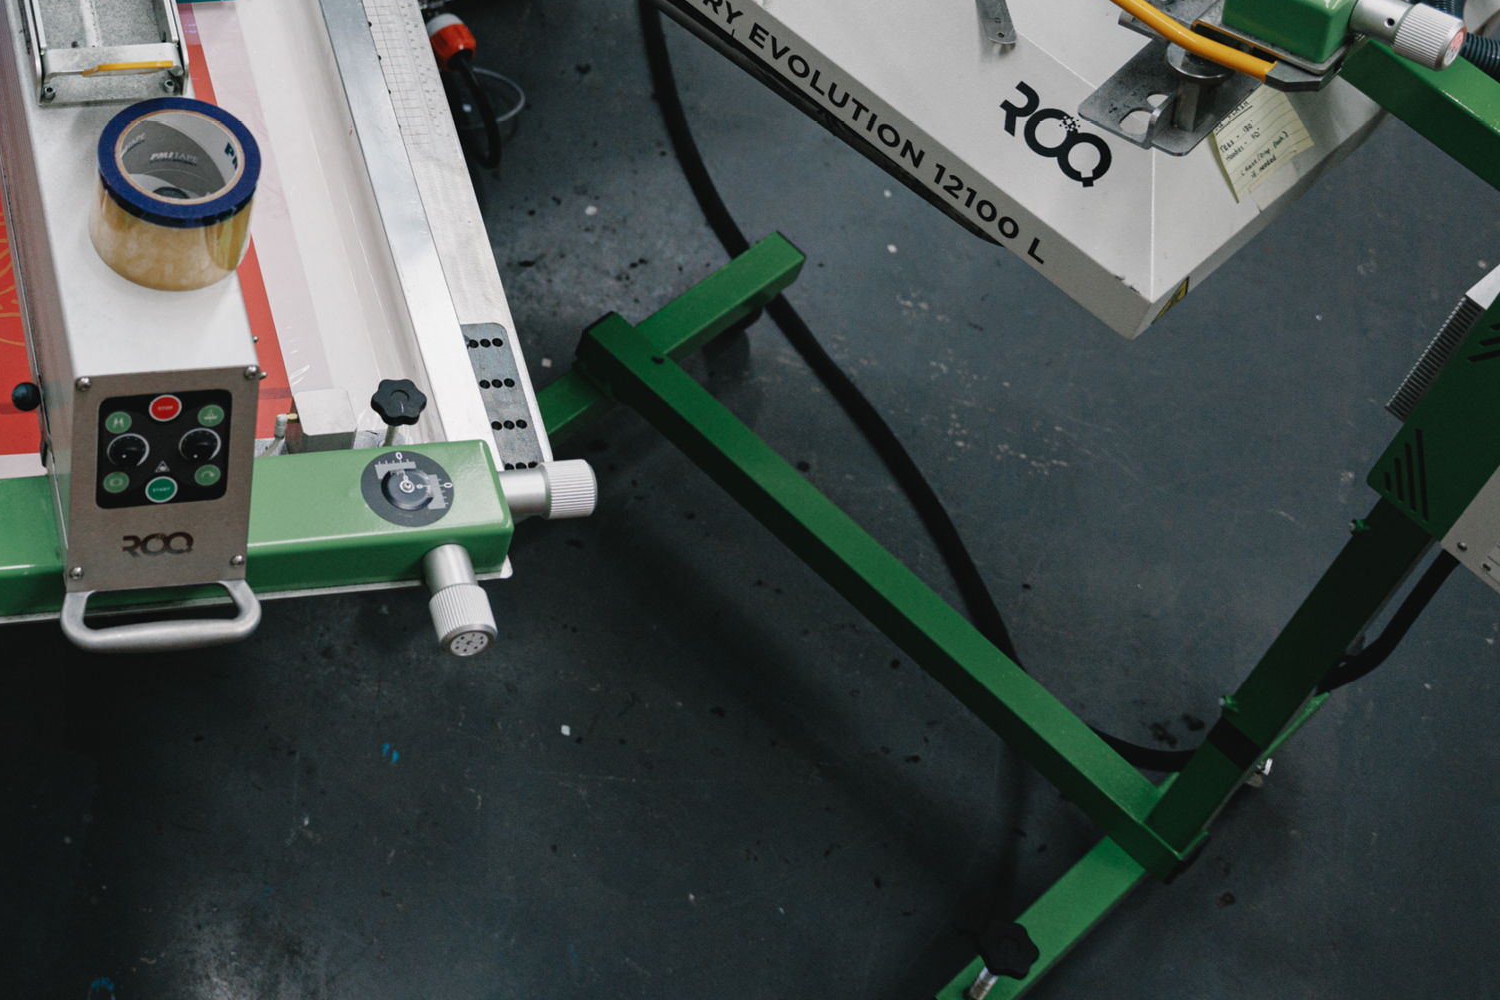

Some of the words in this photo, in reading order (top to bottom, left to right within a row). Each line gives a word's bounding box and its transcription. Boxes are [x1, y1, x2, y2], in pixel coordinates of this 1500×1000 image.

[747, 22, 926, 169] EVOLUTION
[932, 162, 1020, 240] 12100
[1026, 237, 1046, 265] L
[999, 80, 1113, 188] ROQ
[121, 531, 194, 558] ROQ
